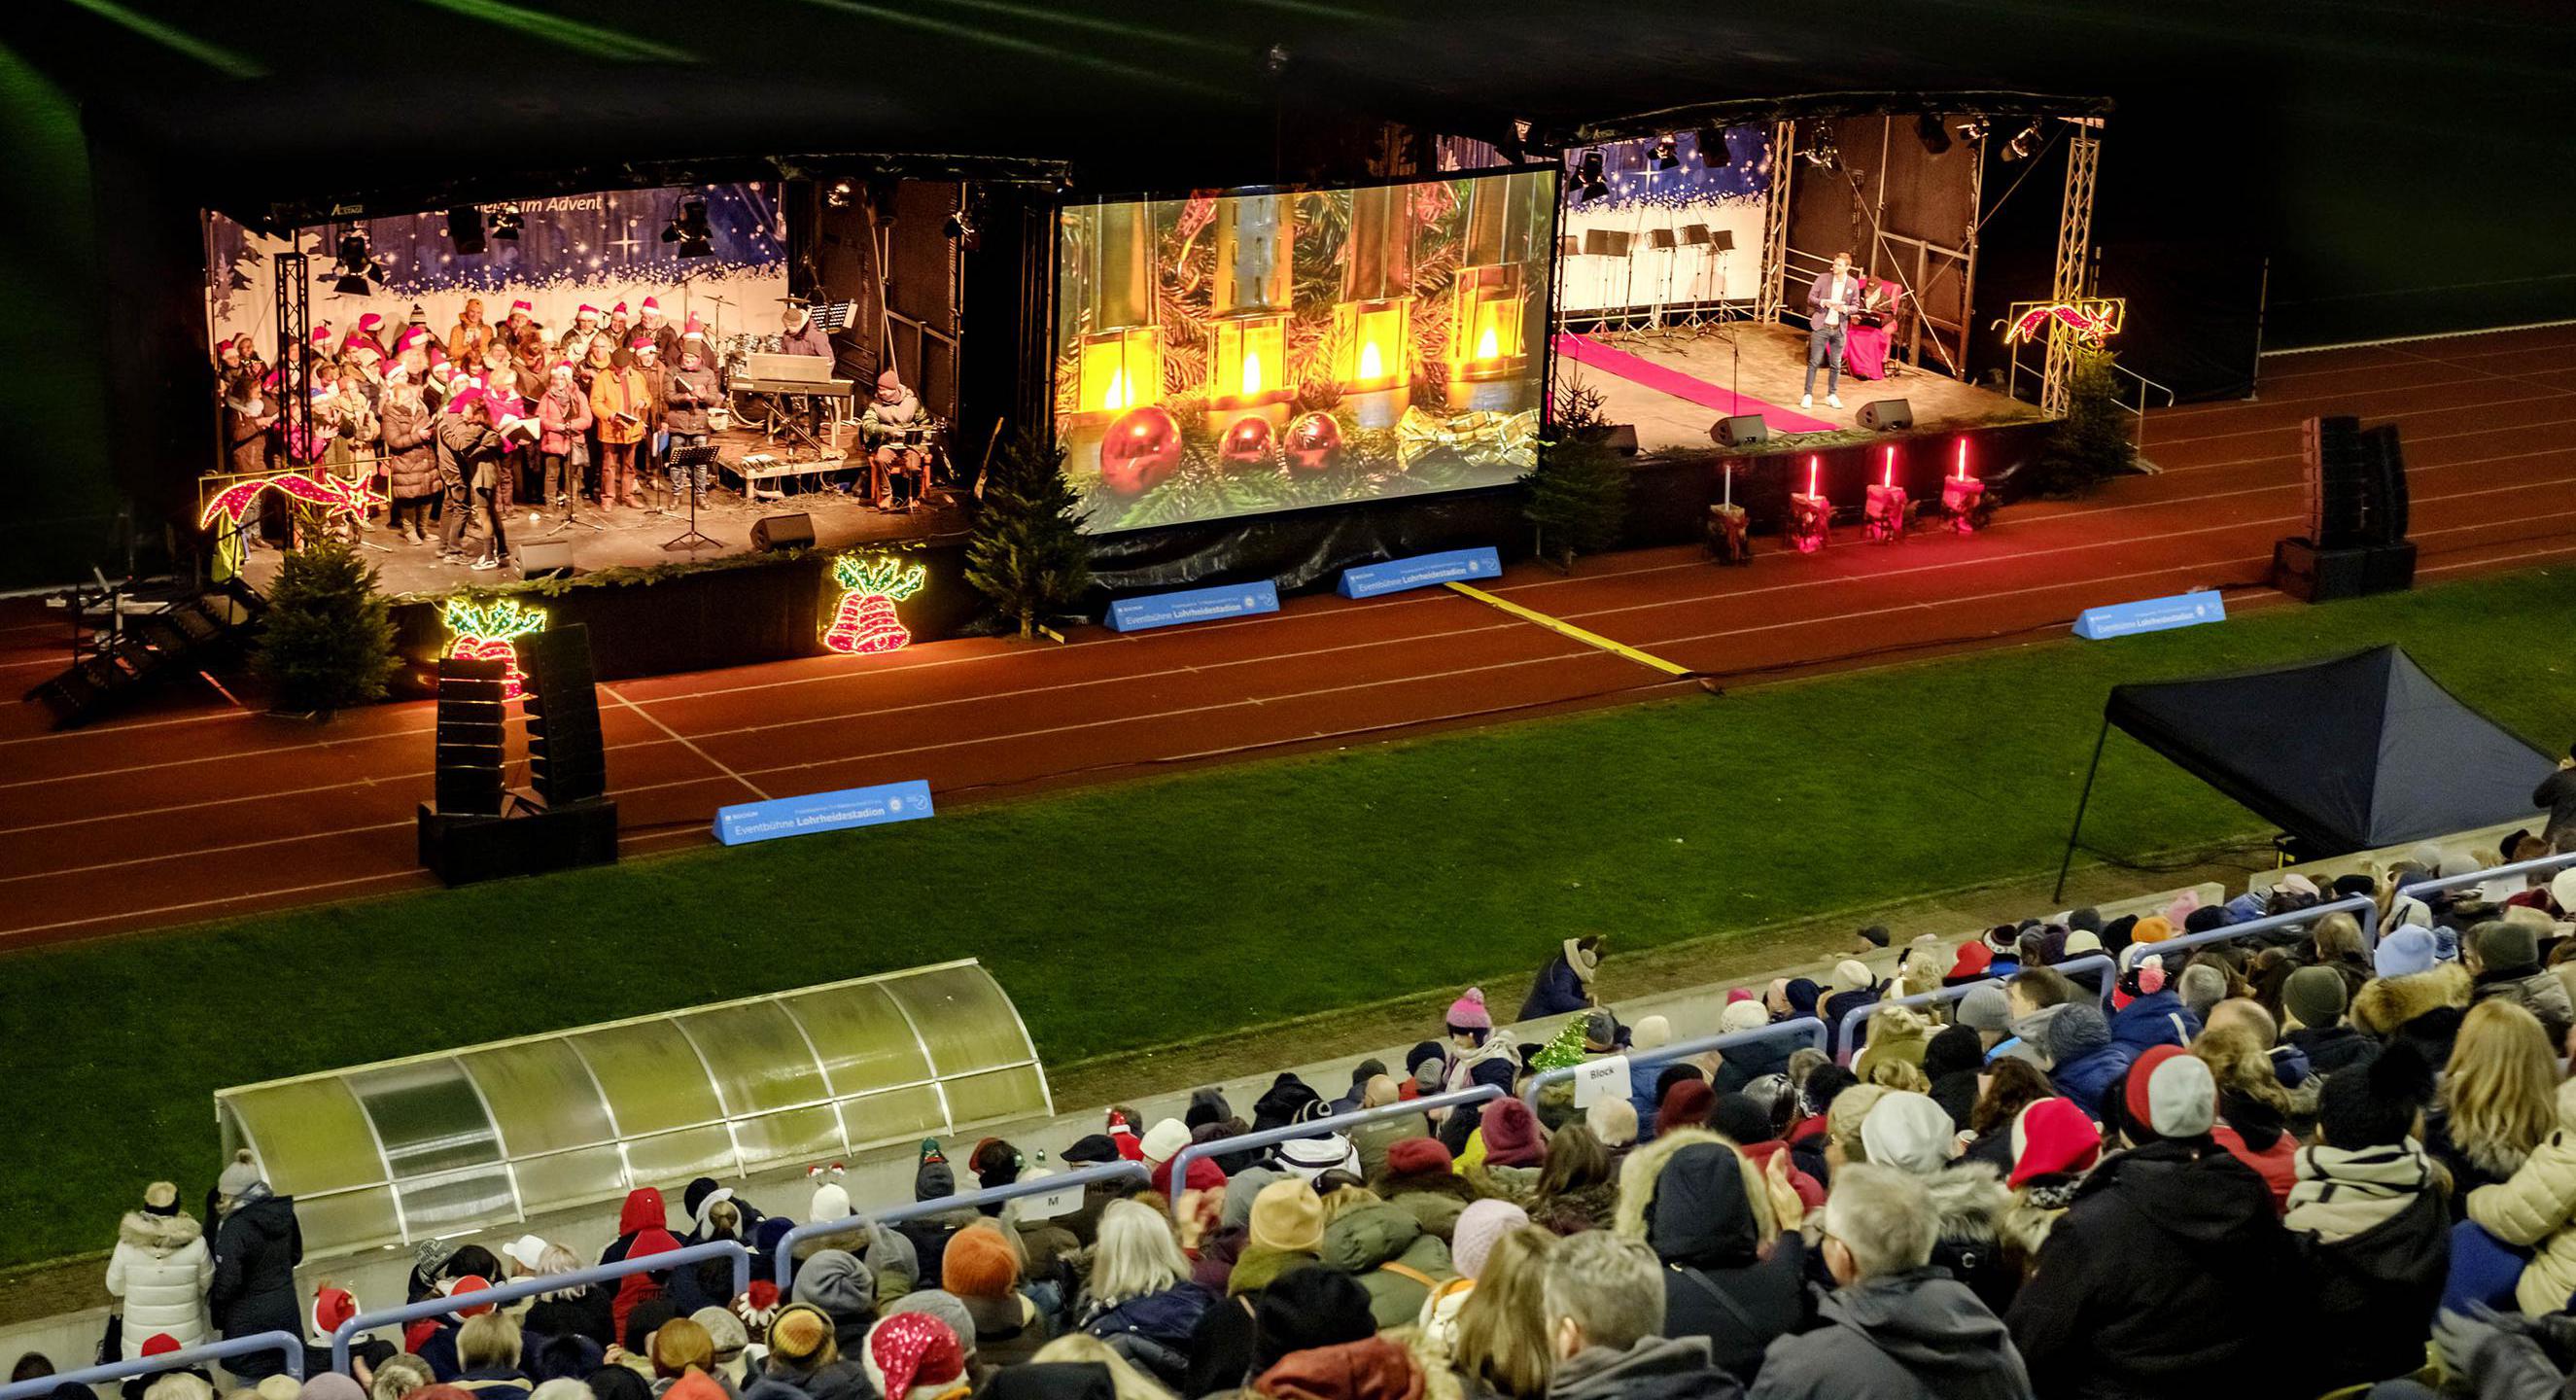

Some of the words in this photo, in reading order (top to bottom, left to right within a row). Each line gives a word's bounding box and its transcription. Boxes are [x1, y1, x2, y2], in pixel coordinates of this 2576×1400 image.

[546, 195, 603, 212] Advent
[735, 819, 794, 835] Eventbühne
[796, 807, 886, 826] Lohrheidestadion
[1590, 1066, 1615, 1080] Block
[1048, 1196, 1060, 1207] M
